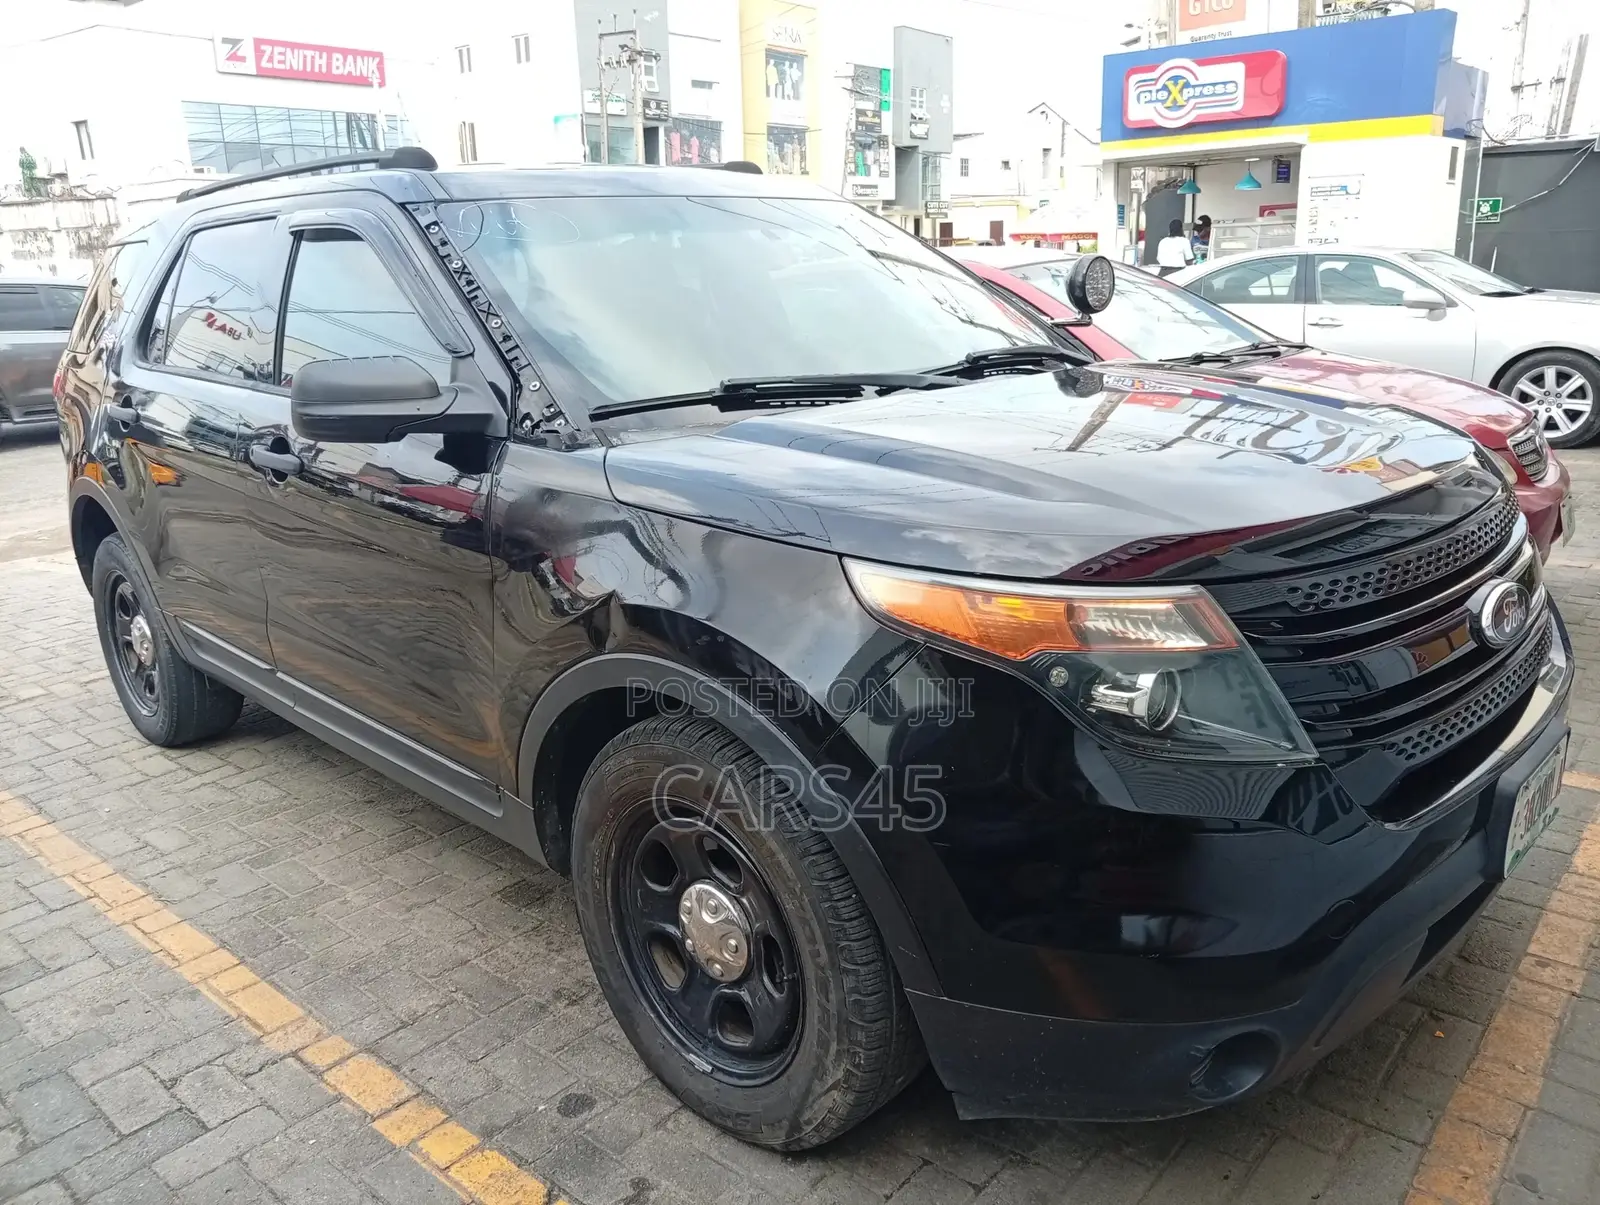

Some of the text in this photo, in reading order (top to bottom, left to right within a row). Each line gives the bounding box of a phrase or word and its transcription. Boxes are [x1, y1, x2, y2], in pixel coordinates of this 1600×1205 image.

[260, 44, 381, 79] ZENITH BANK
[1503, 590, 1527, 633] Ford
